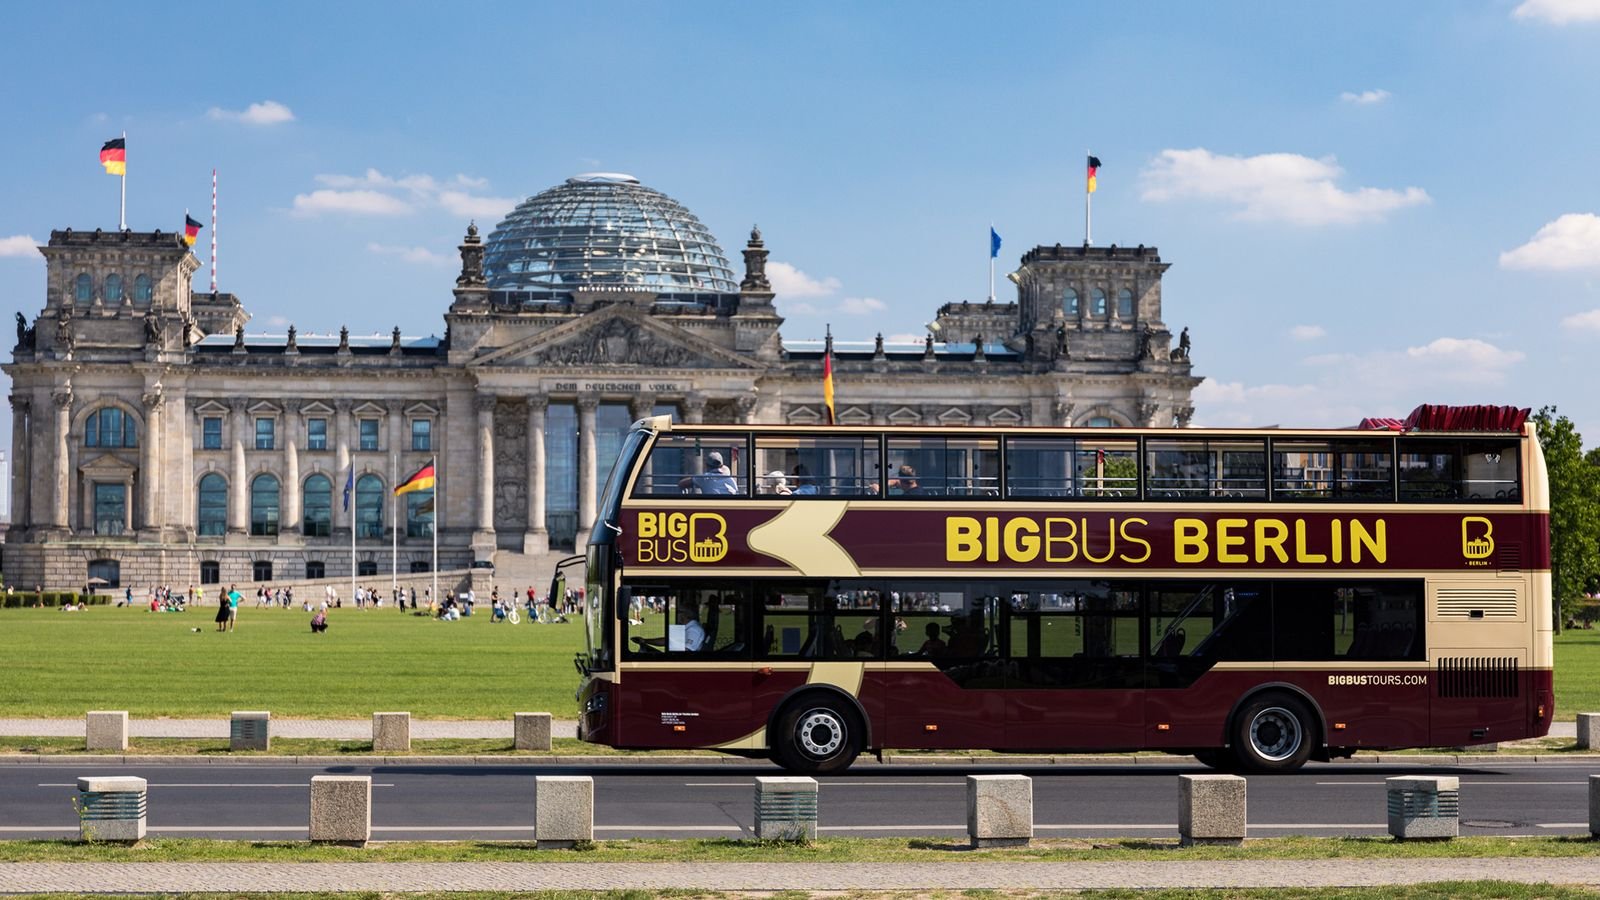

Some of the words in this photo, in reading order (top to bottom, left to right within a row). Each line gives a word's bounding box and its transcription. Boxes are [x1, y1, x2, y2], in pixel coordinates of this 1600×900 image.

[638, 512, 687, 538] BIG
[638, 539, 687, 562] BUS
[1174, 518, 1387, 563] BERLIN
[1328, 675, 1427, 685] BIGBUSTOURS.COM
